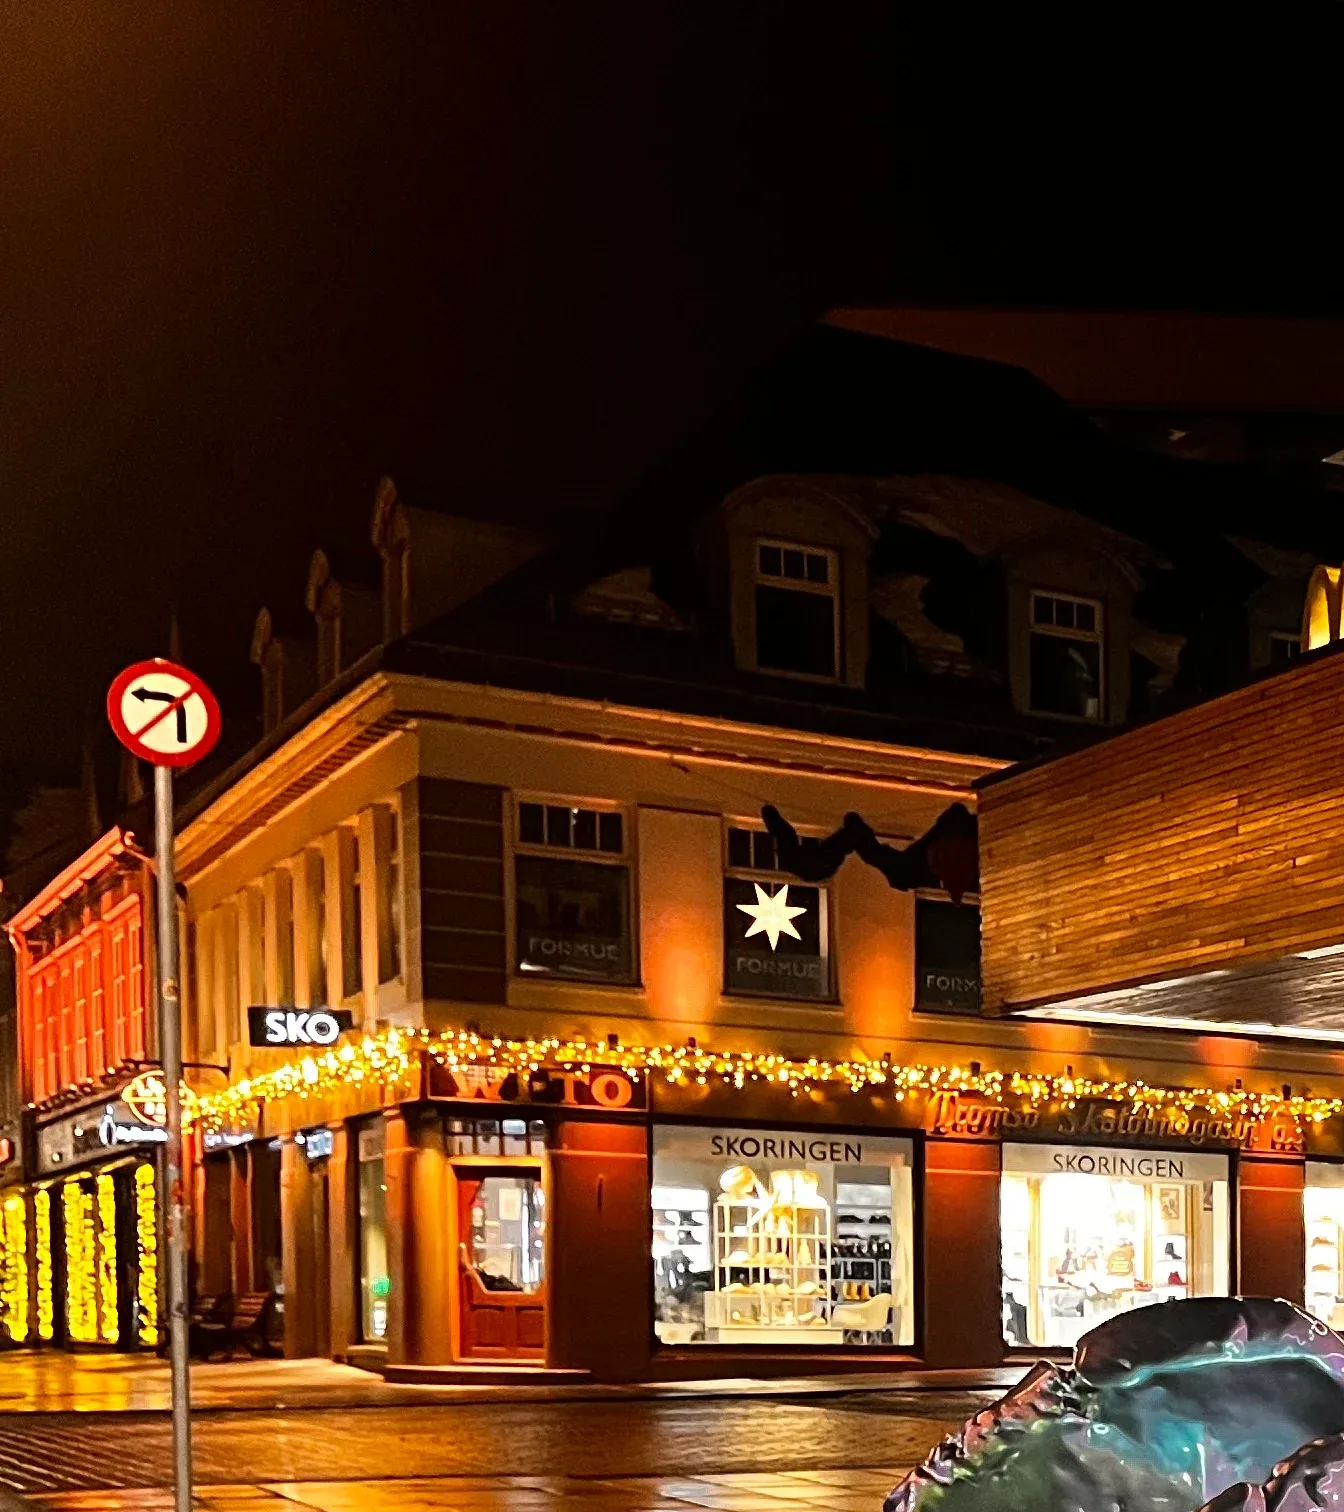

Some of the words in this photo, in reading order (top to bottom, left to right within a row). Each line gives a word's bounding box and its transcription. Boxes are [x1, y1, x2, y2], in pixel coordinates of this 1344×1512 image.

[265, 1011, 340, 1044] SKO
[711, 1135, 862, 1162] SKORINGEN
[1052, 1153, 1184, 1179] SKORINGEN
